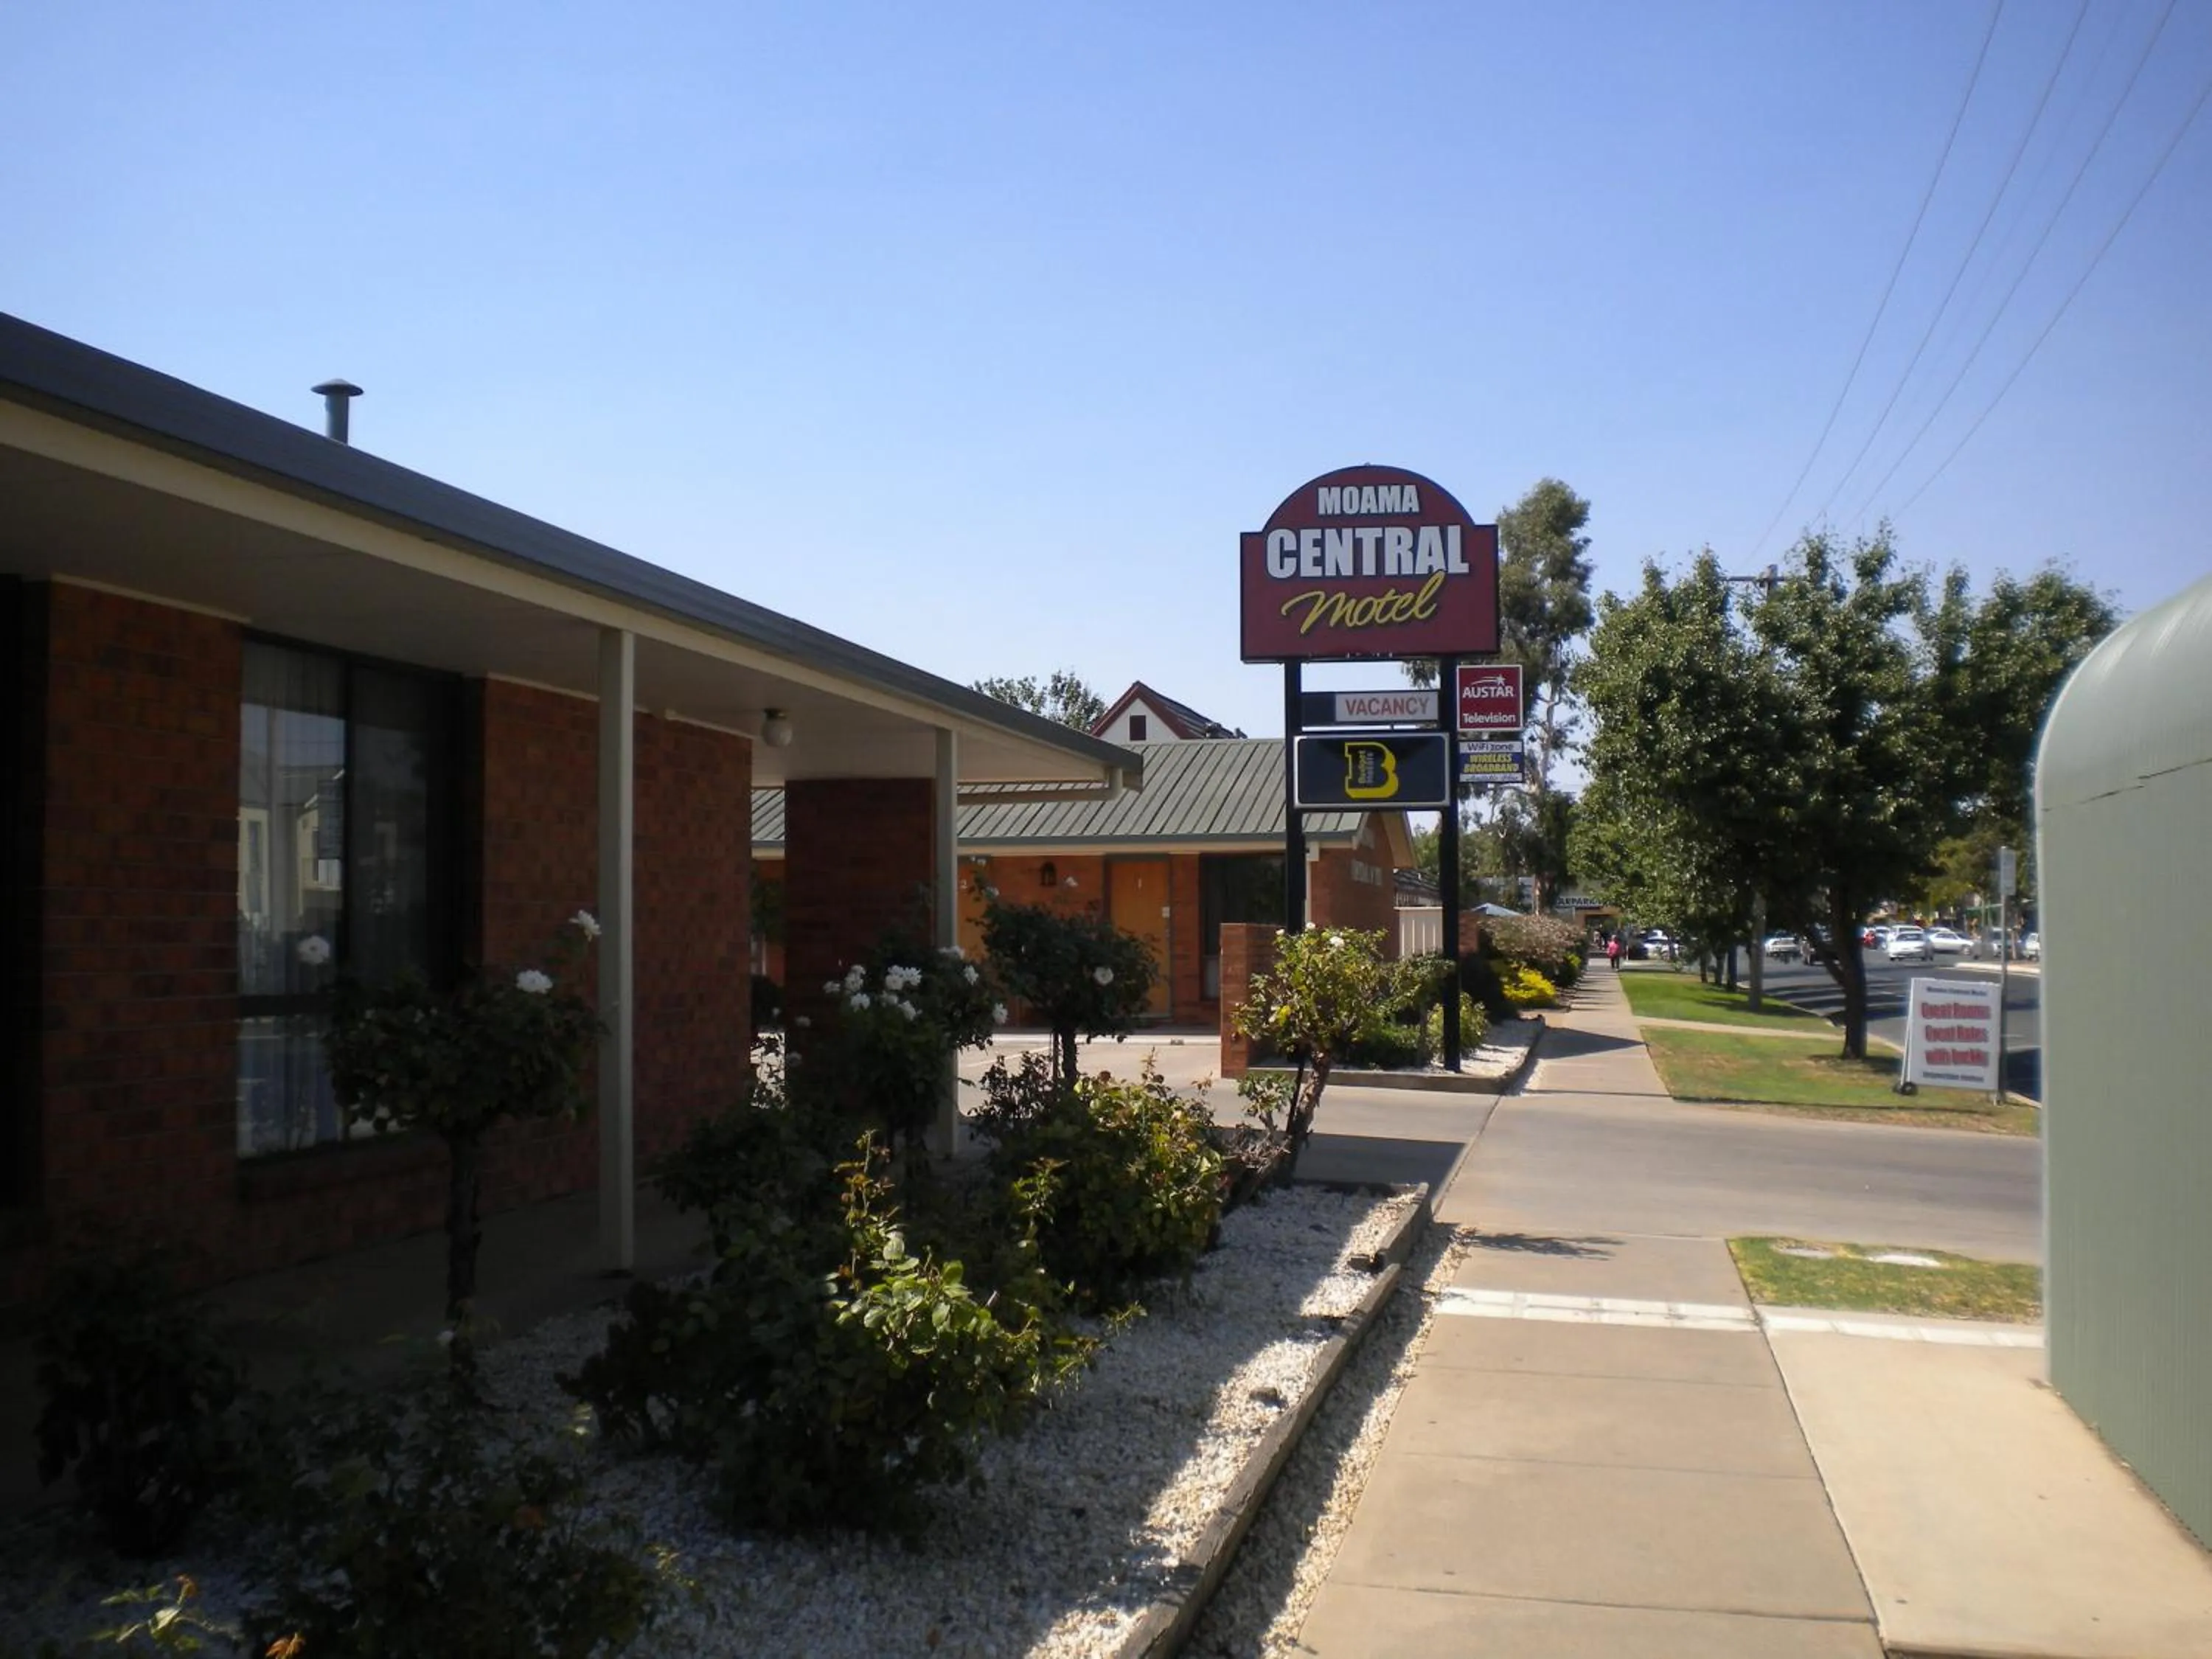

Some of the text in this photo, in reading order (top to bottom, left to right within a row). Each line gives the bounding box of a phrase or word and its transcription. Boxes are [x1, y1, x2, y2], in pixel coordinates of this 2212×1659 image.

[1318, 484, 1419, 515] MOAMA
[1267, 525, 1470, 579] CENTRAL
[1281, 570, 1446, 634] Motel
[1462, 686, 1514, 698] AUSTAR
[1345, 697, 1429, 716] VACANCY
[1463, 712, 1516, 723] Television
